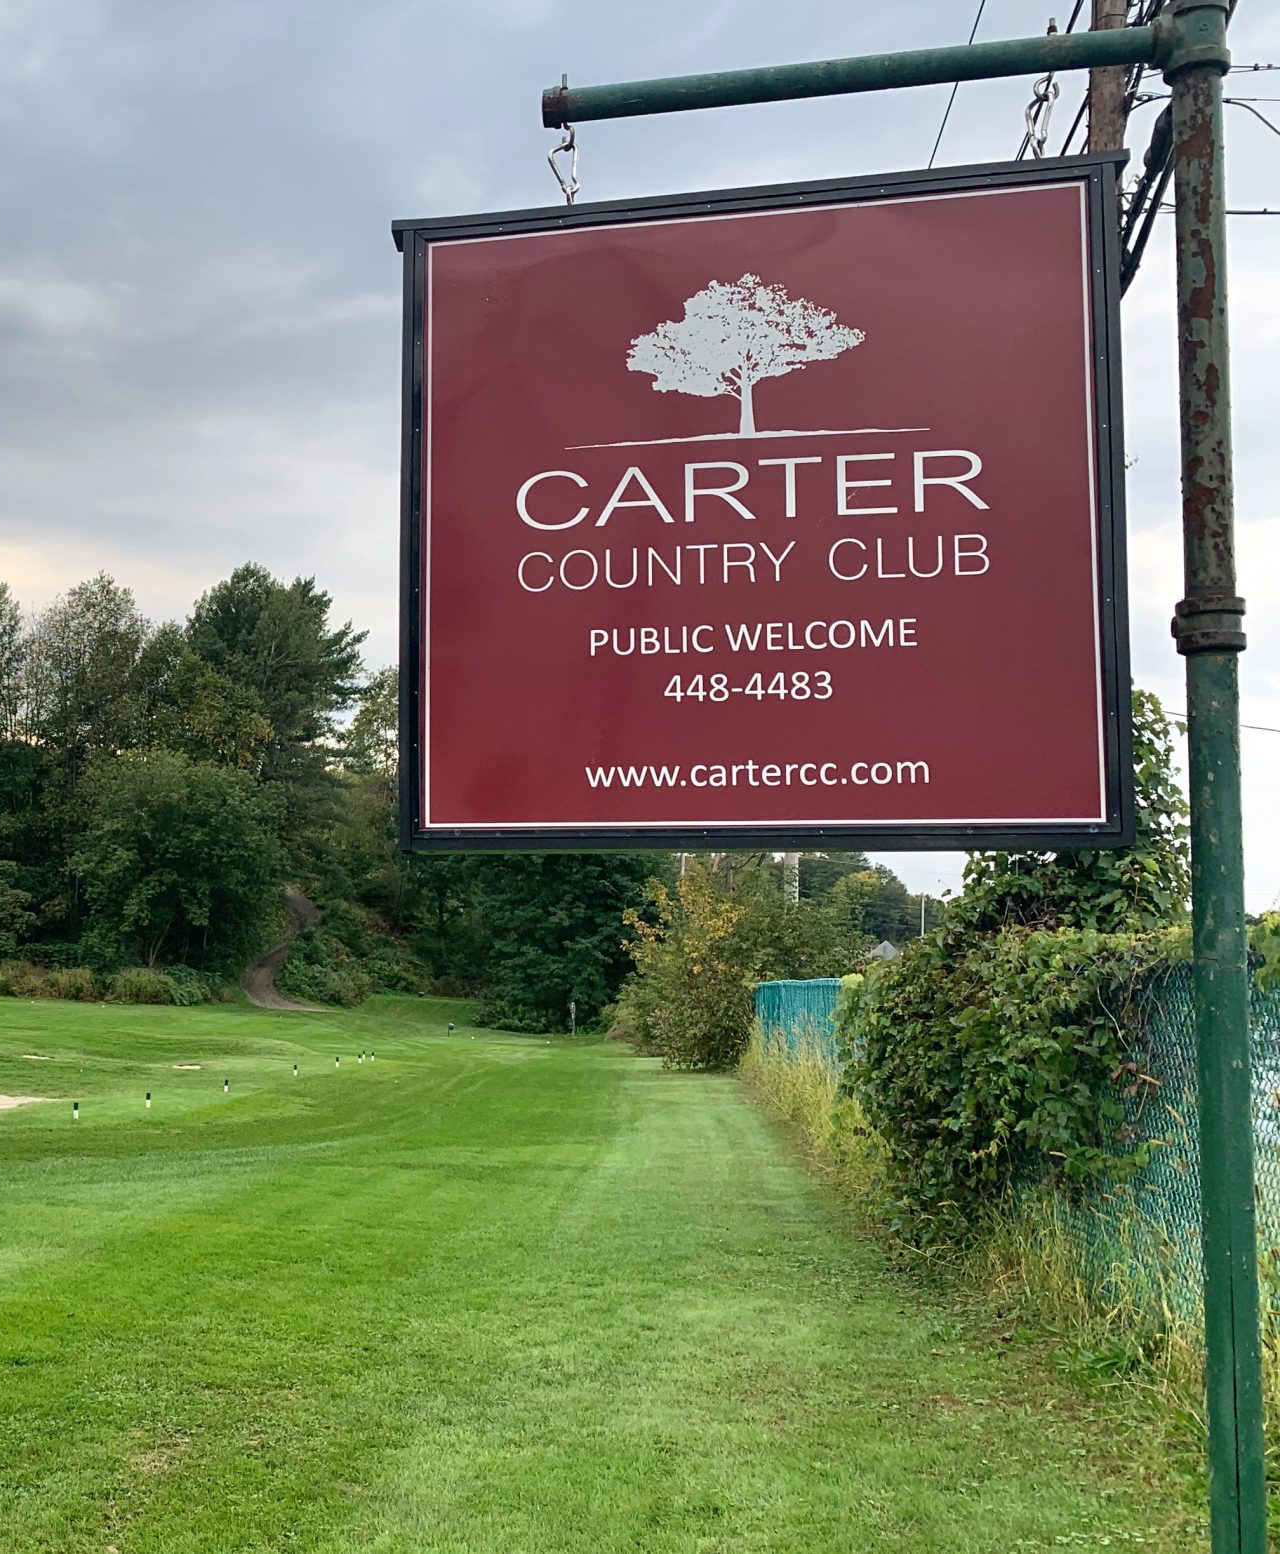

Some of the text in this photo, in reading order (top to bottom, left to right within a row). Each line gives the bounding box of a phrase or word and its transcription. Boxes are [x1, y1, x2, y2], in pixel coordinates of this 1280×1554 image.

[515, 449, 991, 531] CARTER
[517, 533, 990, 593] COUNTRY CLUB
[589, 618, 918, 656] PUBLIC WELCOME
[663, 670, 833, 703] 448-4483
[585, 759, 930, 788] www.cartercc.com
